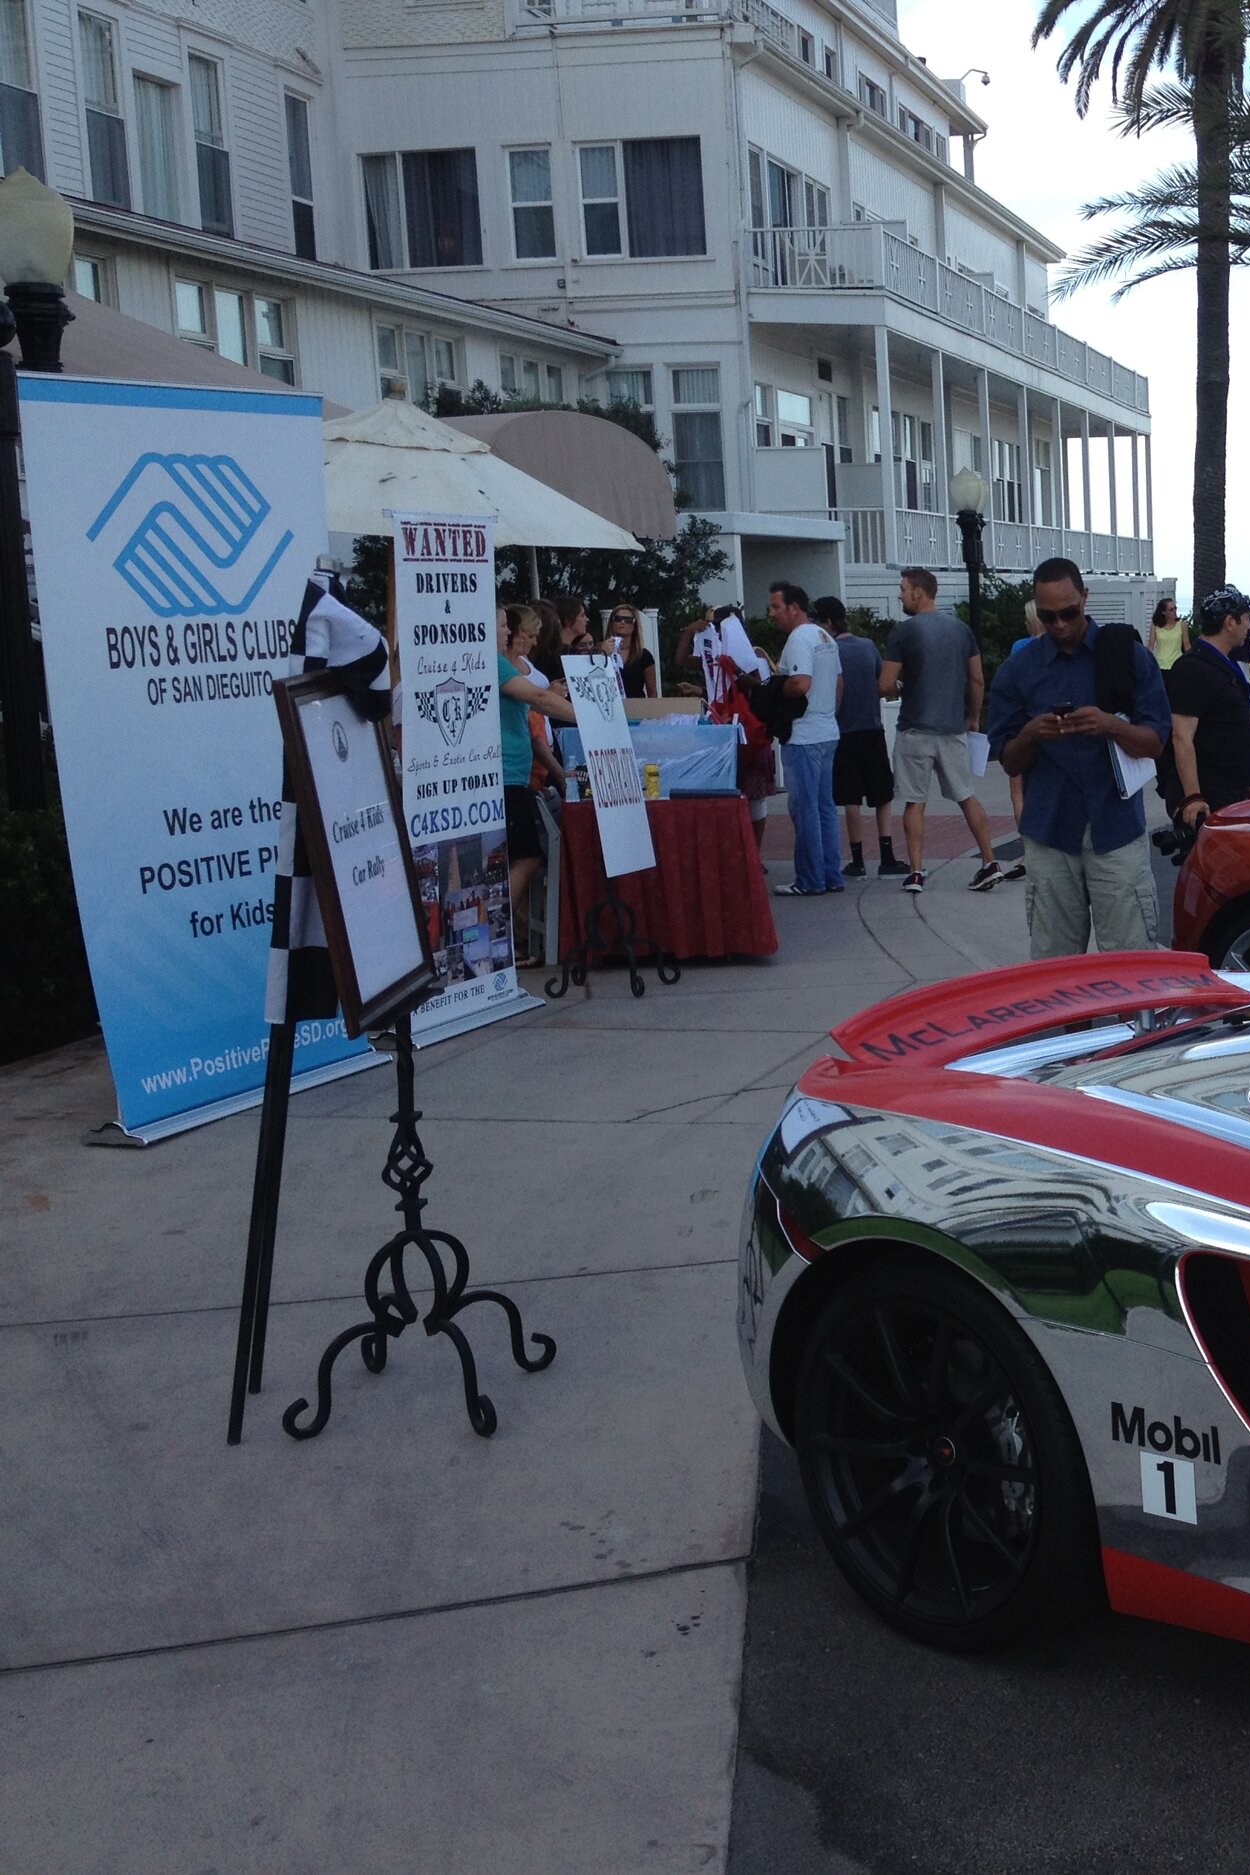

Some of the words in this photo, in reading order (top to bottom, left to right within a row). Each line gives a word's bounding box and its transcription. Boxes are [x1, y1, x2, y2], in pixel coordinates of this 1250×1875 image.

[401, 526, 486, 558] WANTED
[416, 573, 477, 594] DRIVERS
[444, 599, 451, 614] &
[106, 624, 161, 669] BOYS
[166, 624, 180, 666] &
[183, 621, 237, 664] GIRLS
[413, 622, 486, 646] SPONSORS
[417, 656, 448, 675] Cruise
[461, 651, 486, 674] Kids
[147, 677, 167, 705] OF
[172, 676, 203, 704] SAN
[206, 670, 273, 701] DIEGUITO
[407, 758, 431, 776] Sports
[468, 748, 480, 762] Car
[416, 781, 438, 800] SIGN
[443, 779, 458, 795] UP
[461, 772, 499, 791] TODAY!
[163, 807, 202, 836] We
[210, 806, 243, 830] are
[249, 797, 282, 823] the
[333, 816, 359, 843] Cruise
[366, 805, 384, 829] Kids
[410, 798, 505, 838] C4KSD.COM
[139, 850, 252, 894] POSITIVE
[353, 866, 366, 886] Car
[367, 855, 385, 878] Rally
[190, 911, 223, 938] for
[230, 899, 275, 930] Kids
[420, 994, 452, 1013] BENEFIT
[453, 990, 468, 1003] FOR
[471, 984, 485, 997] THE
[1111, 1401, 1221, 1465] Mobil
[1156, 1460, 1177, 1515] 1
